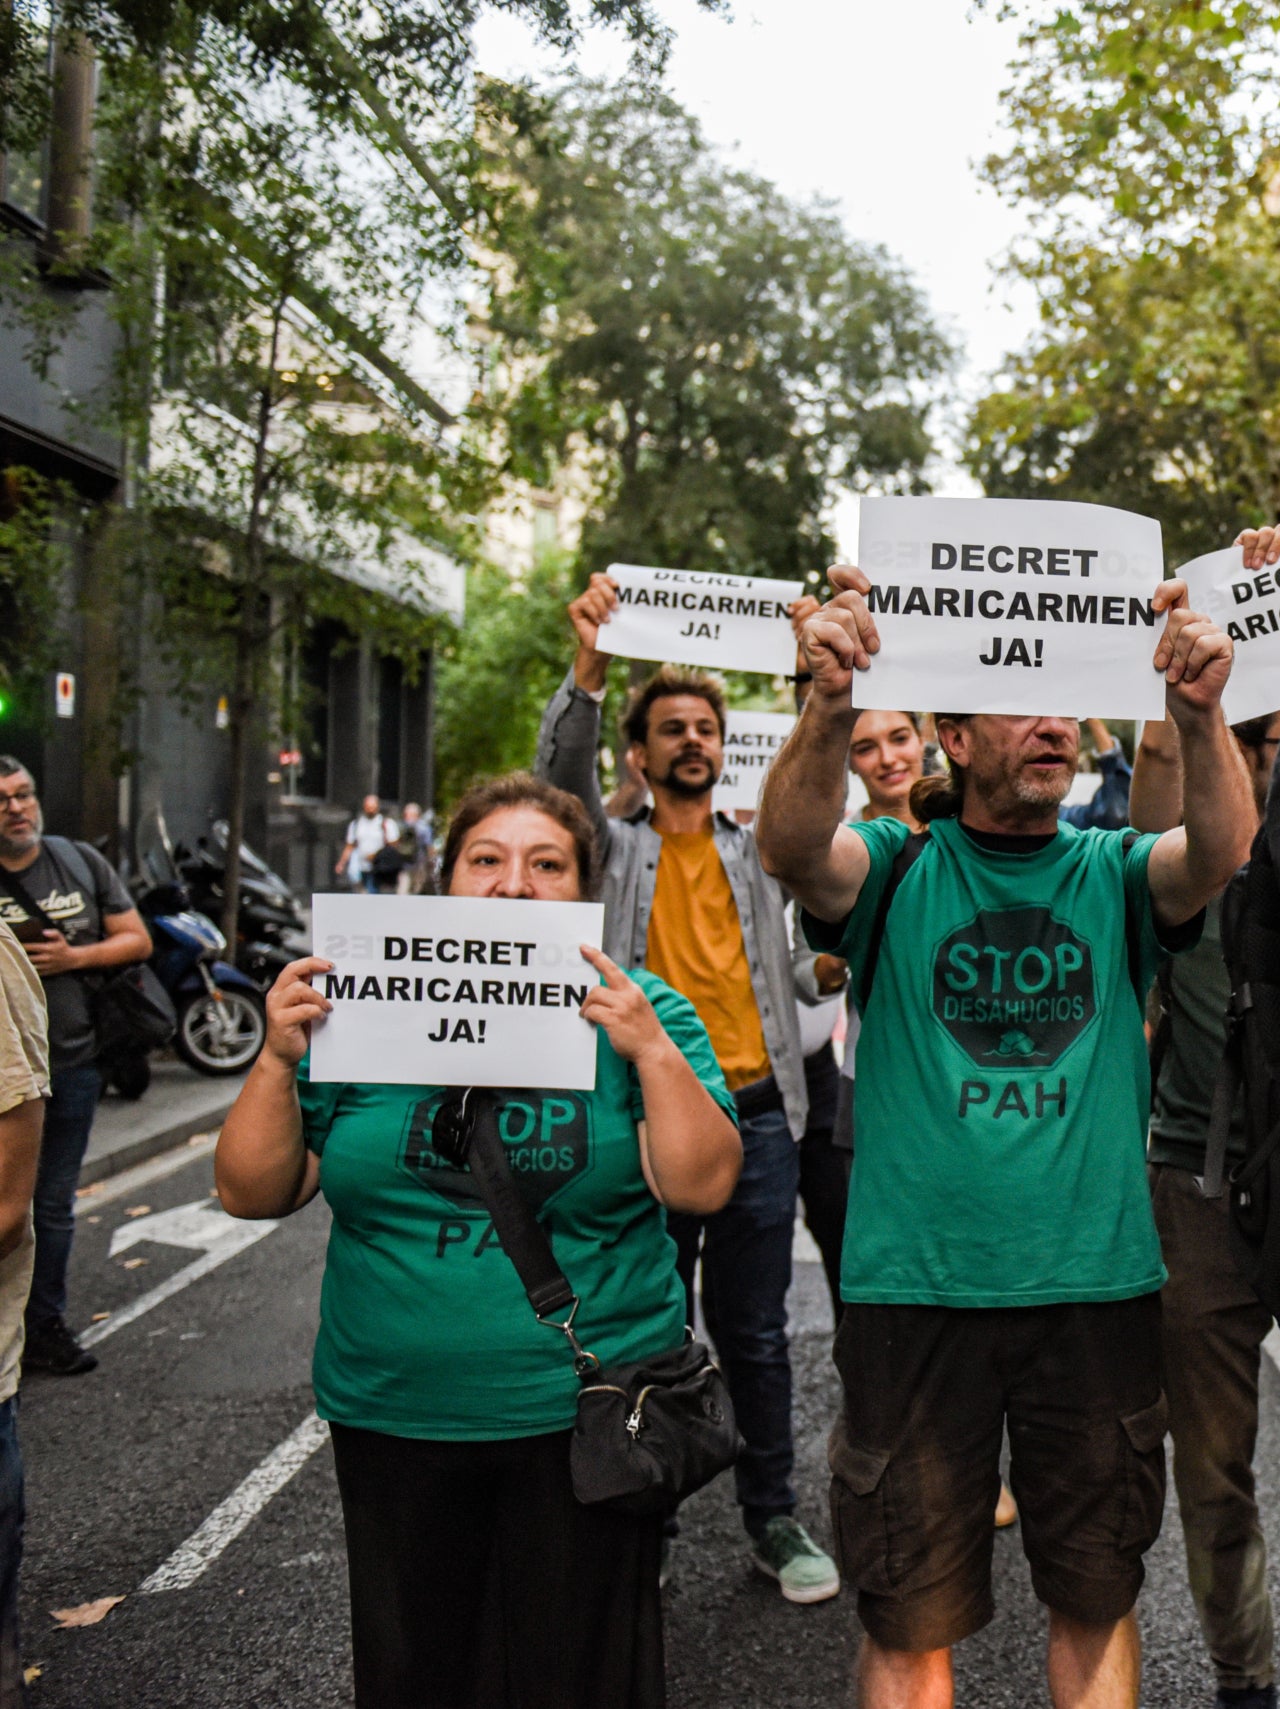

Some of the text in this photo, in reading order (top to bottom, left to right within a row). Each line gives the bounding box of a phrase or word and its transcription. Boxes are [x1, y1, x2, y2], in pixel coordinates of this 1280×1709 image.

[931, 543, 1099, 577] DECRET
[615, 587, 793, 619] MARICARMEN
[867, 585, 1156, 627] MARICARMEN
[680, 622, 721, 640] JA!
[979, 637, 1044, 667] JA!
[721, 774, 738, 787] A!
[384, 936, 536, 967] DECRET
[944, 942, 1083, 994] STOP
[325, 974, 588, 1008] MARICARMEN
[943, 995, 1084, 1023] DESAHUCIOS
[427, 1018, 487, 1044] JA!
[958, 1076, 1067, 1120] PAH
[436, 1221, 505, 1259] PA
